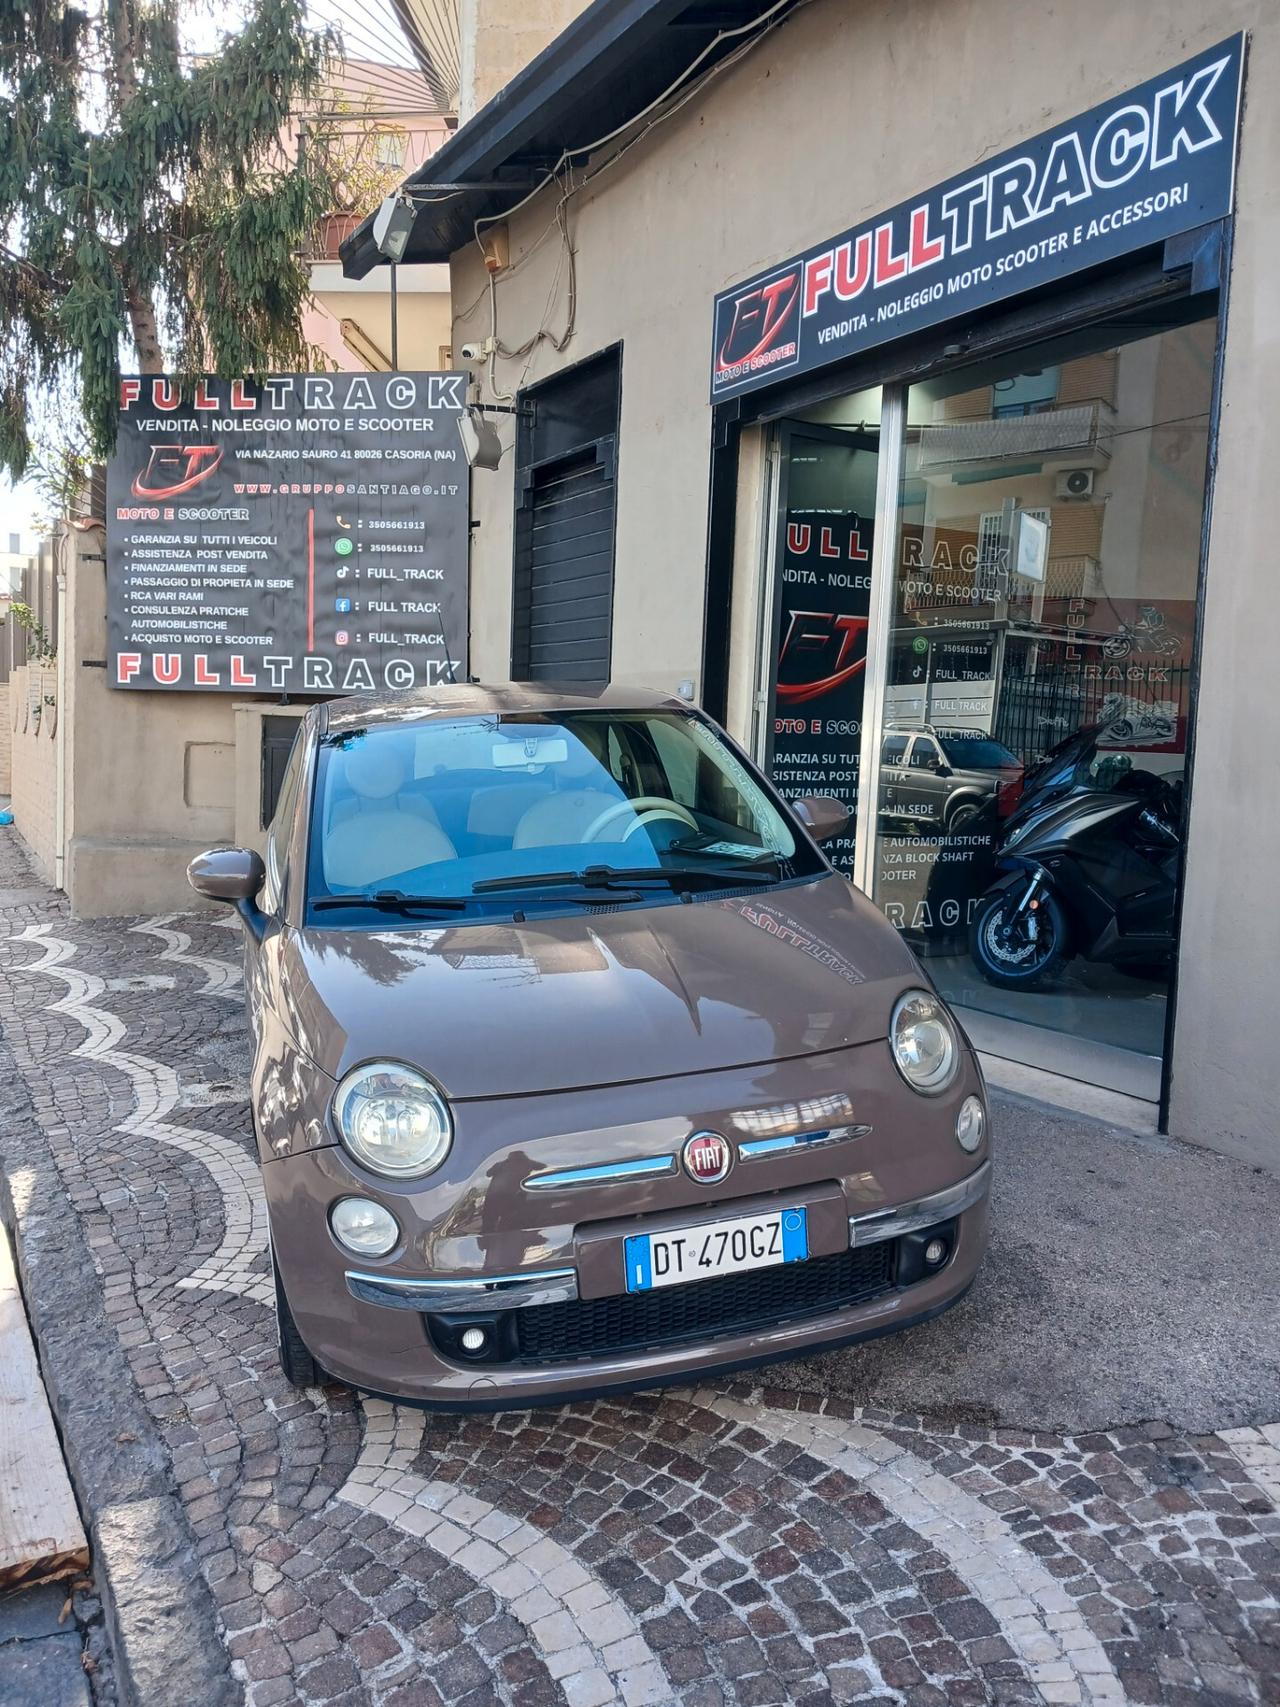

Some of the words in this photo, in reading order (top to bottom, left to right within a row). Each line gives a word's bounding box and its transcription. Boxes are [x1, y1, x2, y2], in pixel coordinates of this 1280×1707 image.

[818, 314, 868, 344] VENDITA
[877, 283, 943, 323] NOLEGGIO
[947, 264, 992, 295] MOTO
[996, 231, 1068, 276] SCOOTER
[1073, 225, 1082, 245] E
[1086, 182, 1189, 240] ACCESSORI
[715, 366, 741, 384] MOTO
[742, 360, 749, 373] E
[750, 342, 796, 370] SCOOTER
[136, 419, 199, 431] VENDITA
[212, 418, 291, 431] NOLEGGIO
[296, 419, 340, 431] MOTO
[345, 419, 354, 431] E
[358, 419, 434, 431] SCOOTER
[235, 450, 251, 459] VIA
[253, 450, 299, 459] NAZARIO
[302, 450, 338, 460] SAURO
[340, 451, 352, 460] 41
[355, 450, 382, 460] 80026
[385, 450, 431, 460] CASORIA
[434, 450, 456, 461] (NA)
[233, 484, 458, 495] WWW.GRUPPOSANTIAGO.IT
[117, 508, 160, 520] MOTO
[163, 508, 174, 520] E
[178, 508, 250, 520] SCOOTER
[369, 521, 425, 529] 3505661913
[131, 535, 181, 544] GARANZIA
[183, 536, 197, 544] SU
[202, 536, 230, 545] TUTTI
[238, 536, 278, 545] VEICOLI
[787, 522, 868, 561] ULL
[370, 544, 424, 553] 3505661913
[131, 550, 192, 558] ASSISTENZA
[197, 550, 223, 559] POST
[225, 551, 268, 560] VENDITA
[131, 564, 206, 572] FINANZIAMENTI
[207, 564, 217, 573] IN
[220, 564, 247, 573] SEDE
[367, 568, 444, 581] FULL_TRACK
[130, 577, 189, 587] PASSAGGIO
[191, 578, 201, 587] DI
[203, 578, 252, 588] PROPIETA
[254, 579, 264, 588] IN
[266, 579, 294, 588] SEDE
[782, 569, 817, 584] NDITA
[828, 573, 872, 589] NOLEG
[936, 584, 944, 595] E
[946, 585, 1001, 600] SCOOTER
[130, 591, 151, 600] RCA
[154, 592, 176, 600] VARI
[178, 592, 204, 600] RAMI
[131, 606, 197, 615] CONSULENZA
[200, 607, 249, 616] PRATICHE
[368, 601, 398, 612] FULL
[401, 602, 441, 613] TRACK
[131, 620, 228, 630] AUTOMOBILISTICHE
[131, 634, 182, 643] ACQUISTO
[184, 635, 213, 643] MOTO
[215, 635, 222, 644] E
[224, 636, 273, 645] SCOOTER
[368, 633, 444, 645] FULL_TRACK
[774, 719, 806, 734] OTO
[811, 719, 822, 734] E
[773, 753, 819, 764] RANZIA
[821, 754, 836, 764] SU
[772, 771, 826, 781] SISTENZA
[829, 771, 858, 781] POST
[778, 788, 849, 798] ANZIAMENTI
[908, 805, 934, 815] SEDE
[890, 836, 991, 847] AUTOMOBILISTICHE
[906, 853, 940, 863] BLOCK
[942, 852, 974, 862] SHAFT
[694, 1145, 721, 1171] FIAT
[653, 1239, 686, 1276] DT
[698, 1222, 783, 1268] 470GZ
